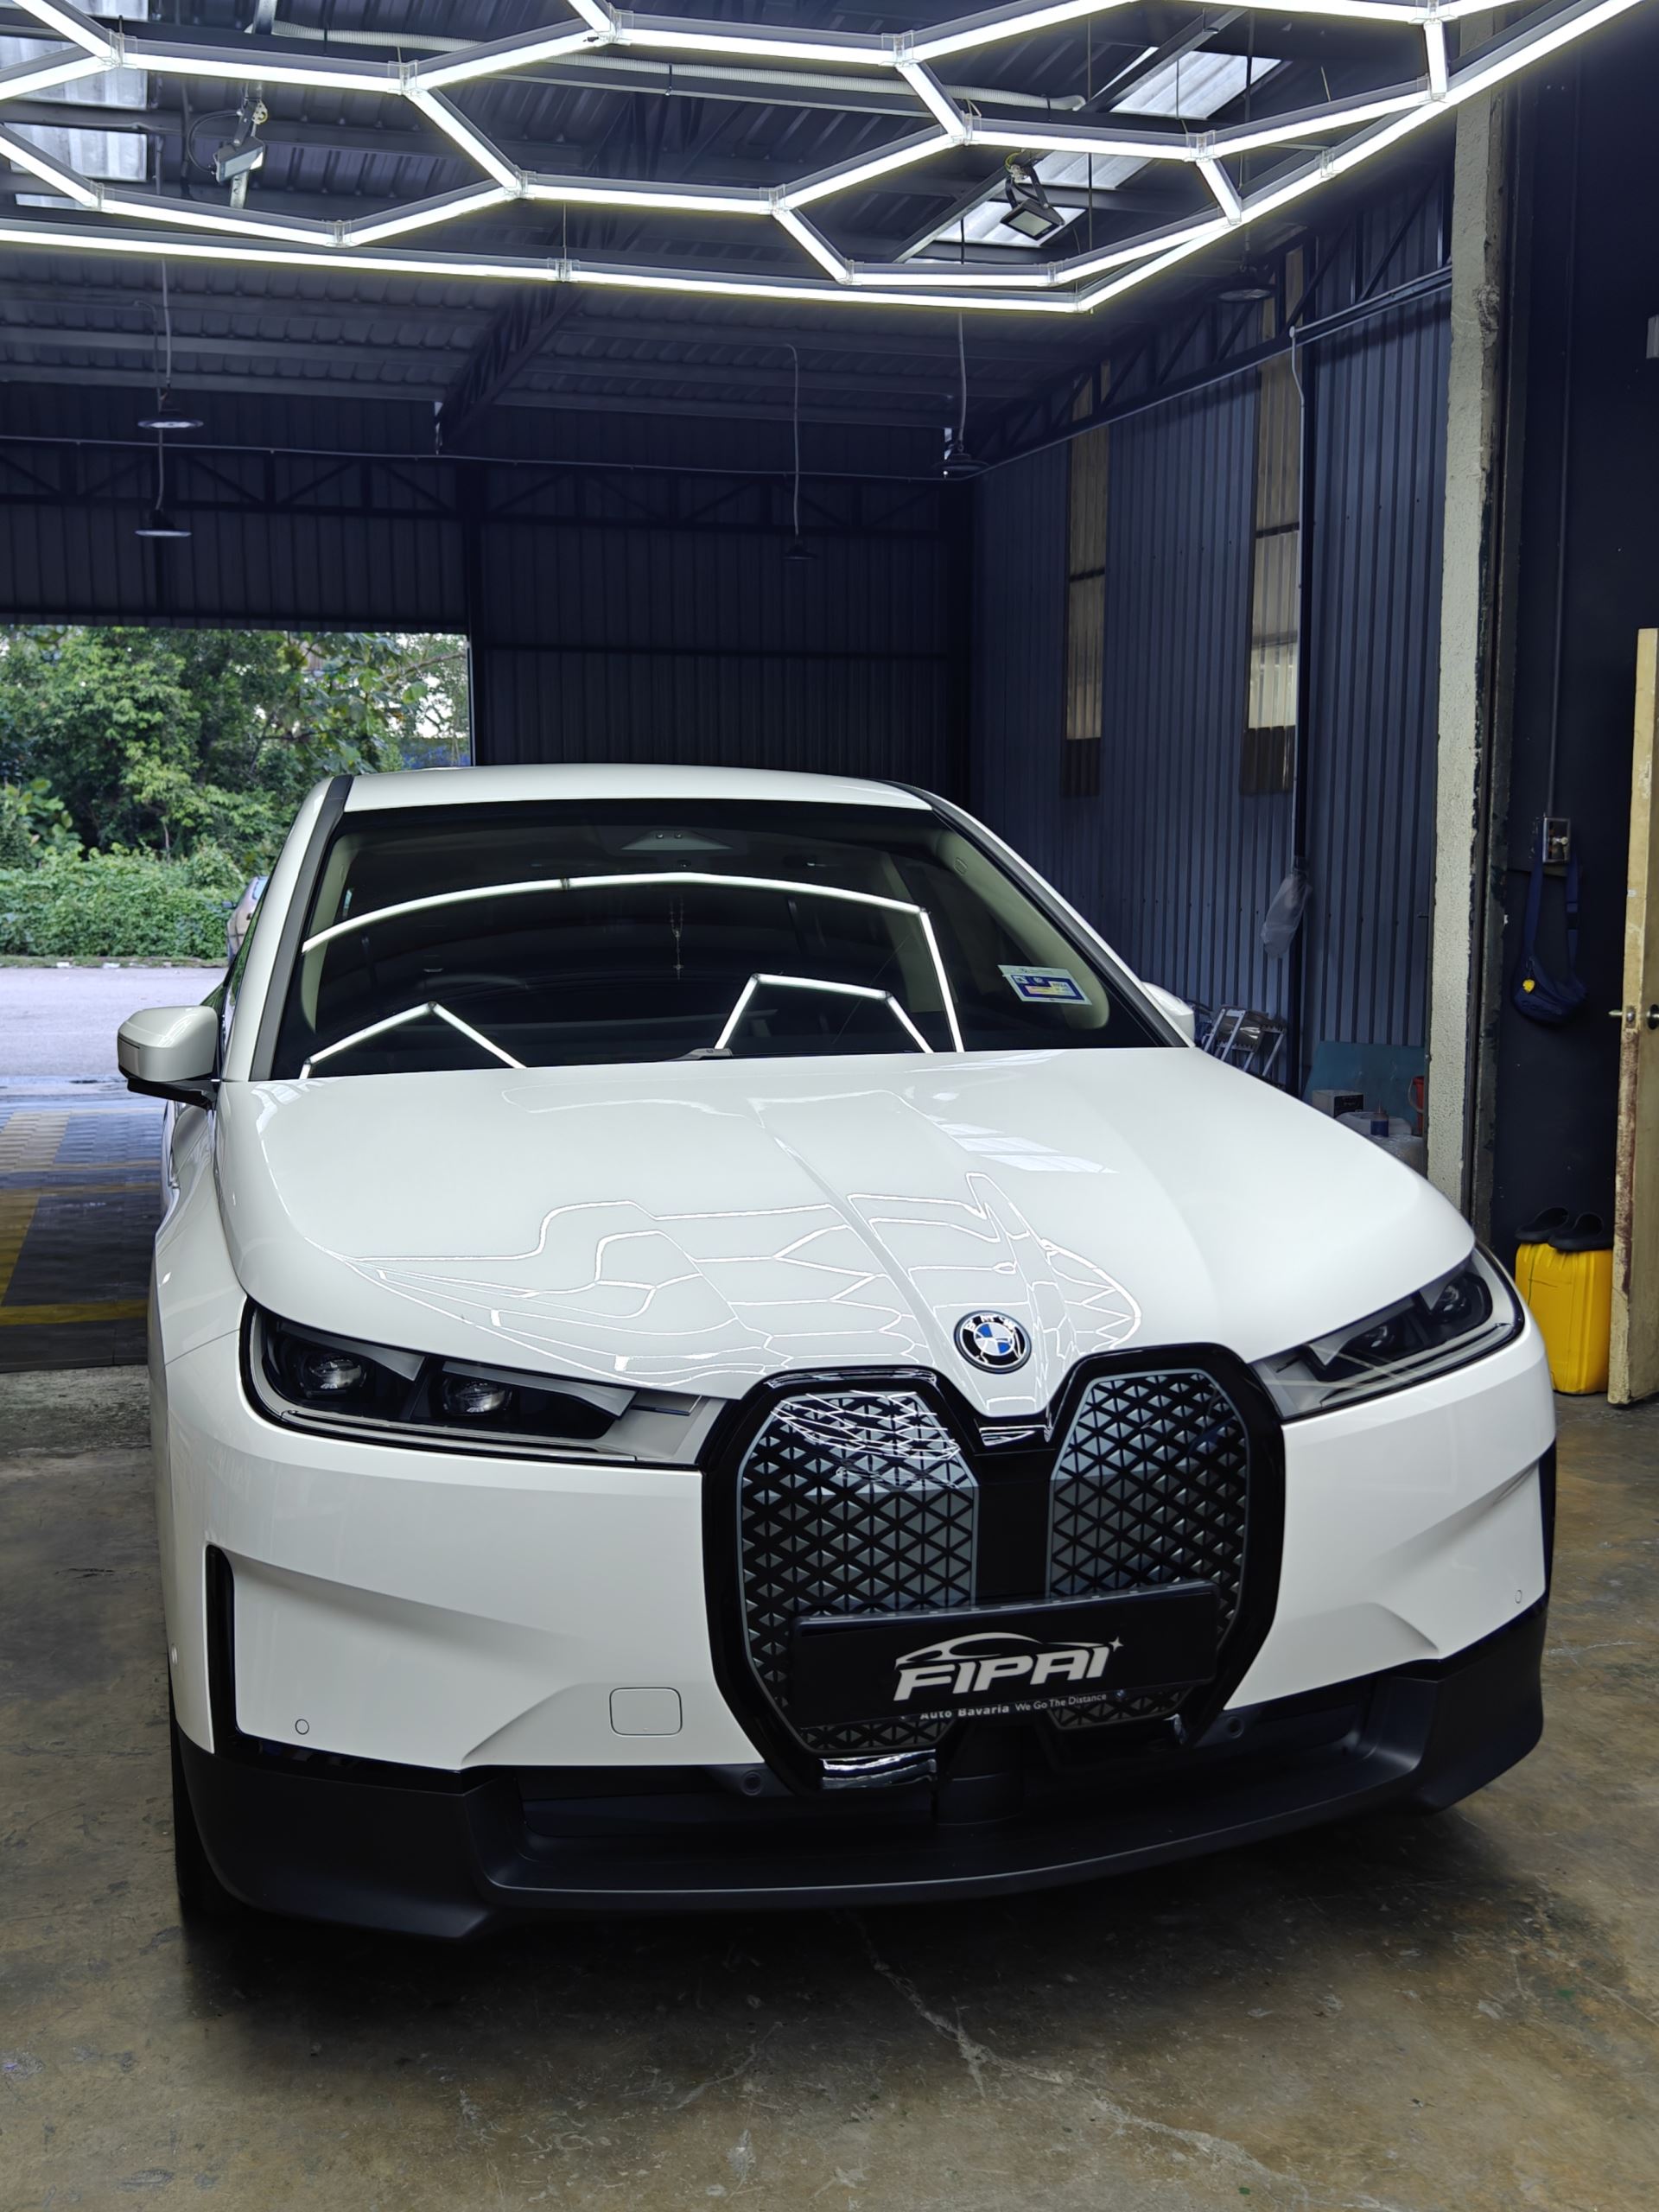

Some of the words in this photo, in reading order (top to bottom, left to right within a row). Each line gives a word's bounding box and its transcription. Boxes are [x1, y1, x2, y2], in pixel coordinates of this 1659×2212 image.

[963, 1313, 1016, 1332] BMW
[893, 1646, 1109, 1701] FIPAI
[920, 1711, 952, 1720] Auto
[957, 1705, 1010, 1717] Bavaria
[1015, 1702, 1031, 1711] We
[1033, 1700, 1047, 1709] Go
[1050, 1699, 1065, 1707] The
[1068, 1694, 1107, 1705] Distance
